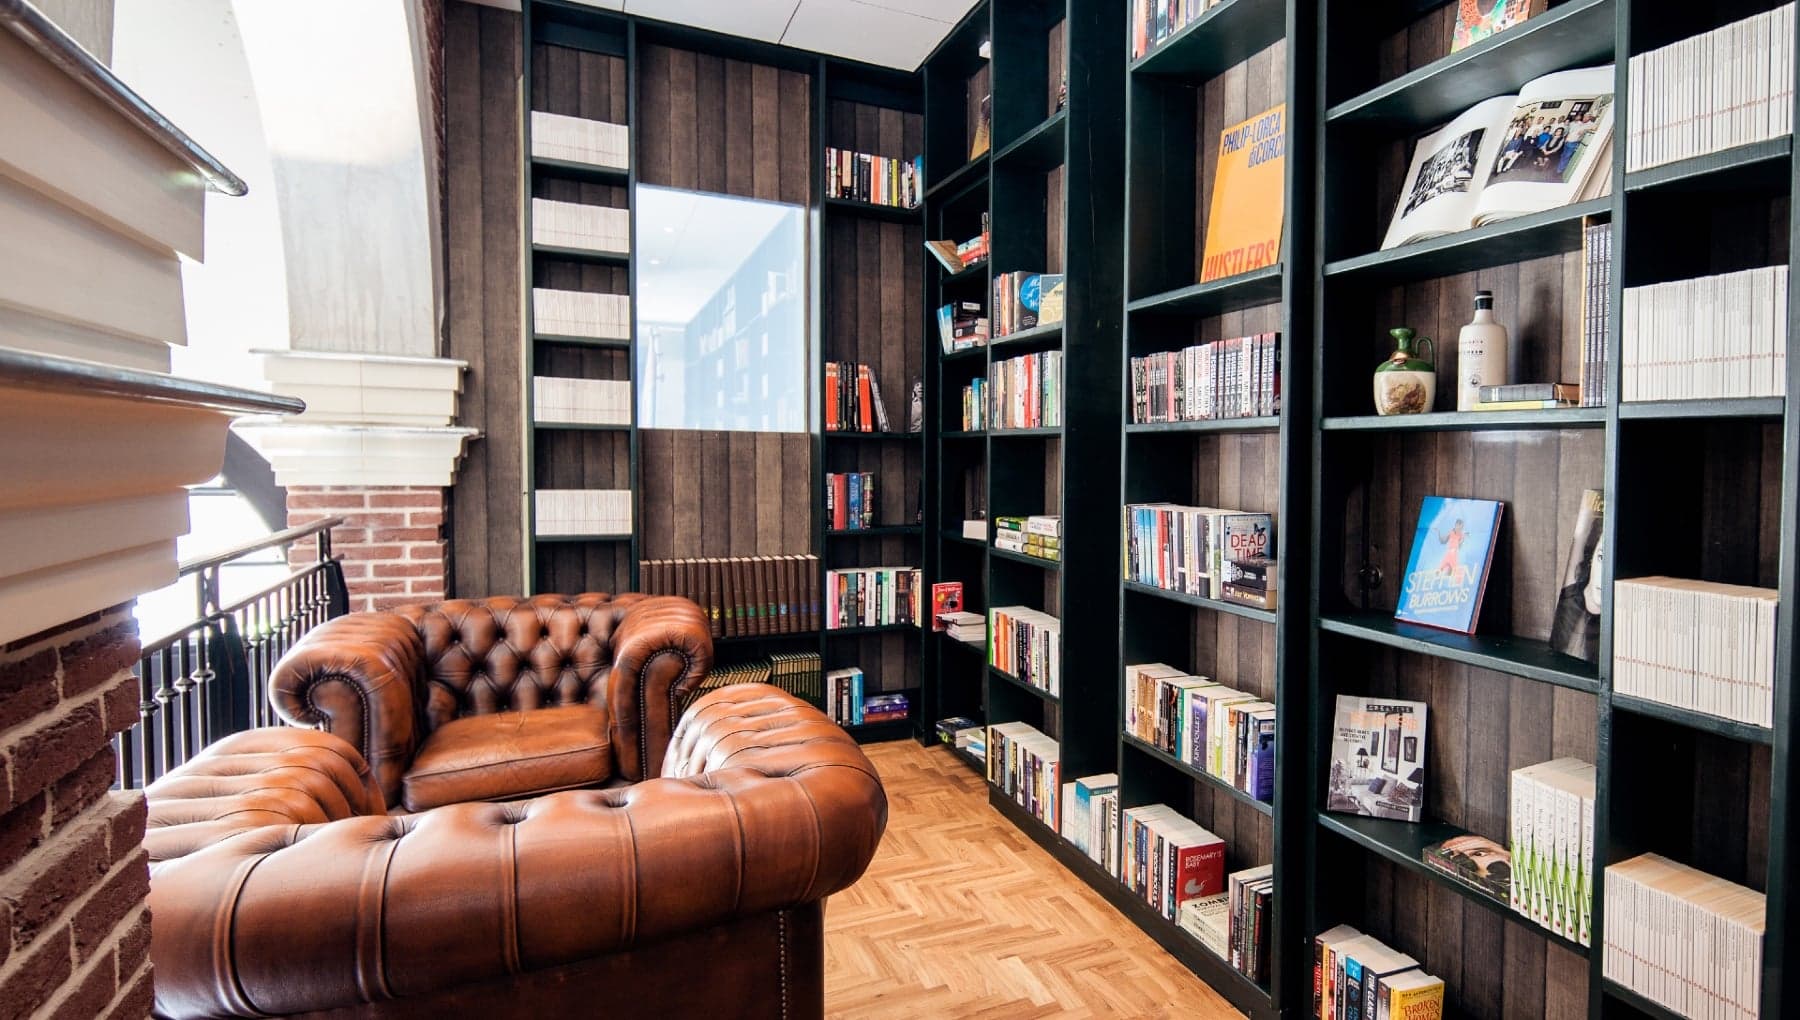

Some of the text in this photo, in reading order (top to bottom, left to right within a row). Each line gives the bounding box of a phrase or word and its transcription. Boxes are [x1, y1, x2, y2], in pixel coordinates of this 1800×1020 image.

[1222, 112, 1281, 156] PHILIP-LORCA
[1205, 239, 1275, 281] HUSTLERS
[1230, 533, 1267, 548] DEAD
[1406, 561, 1479, 593] STEPHEN
[1409, 587, 1470, 609] BURROWS
[1192, 896, 1229, 908] ZOMBI
[1366, 973, 1376, 1020] TOM CLANCY
[1401, 998, 1441, 1017] BROKEN
